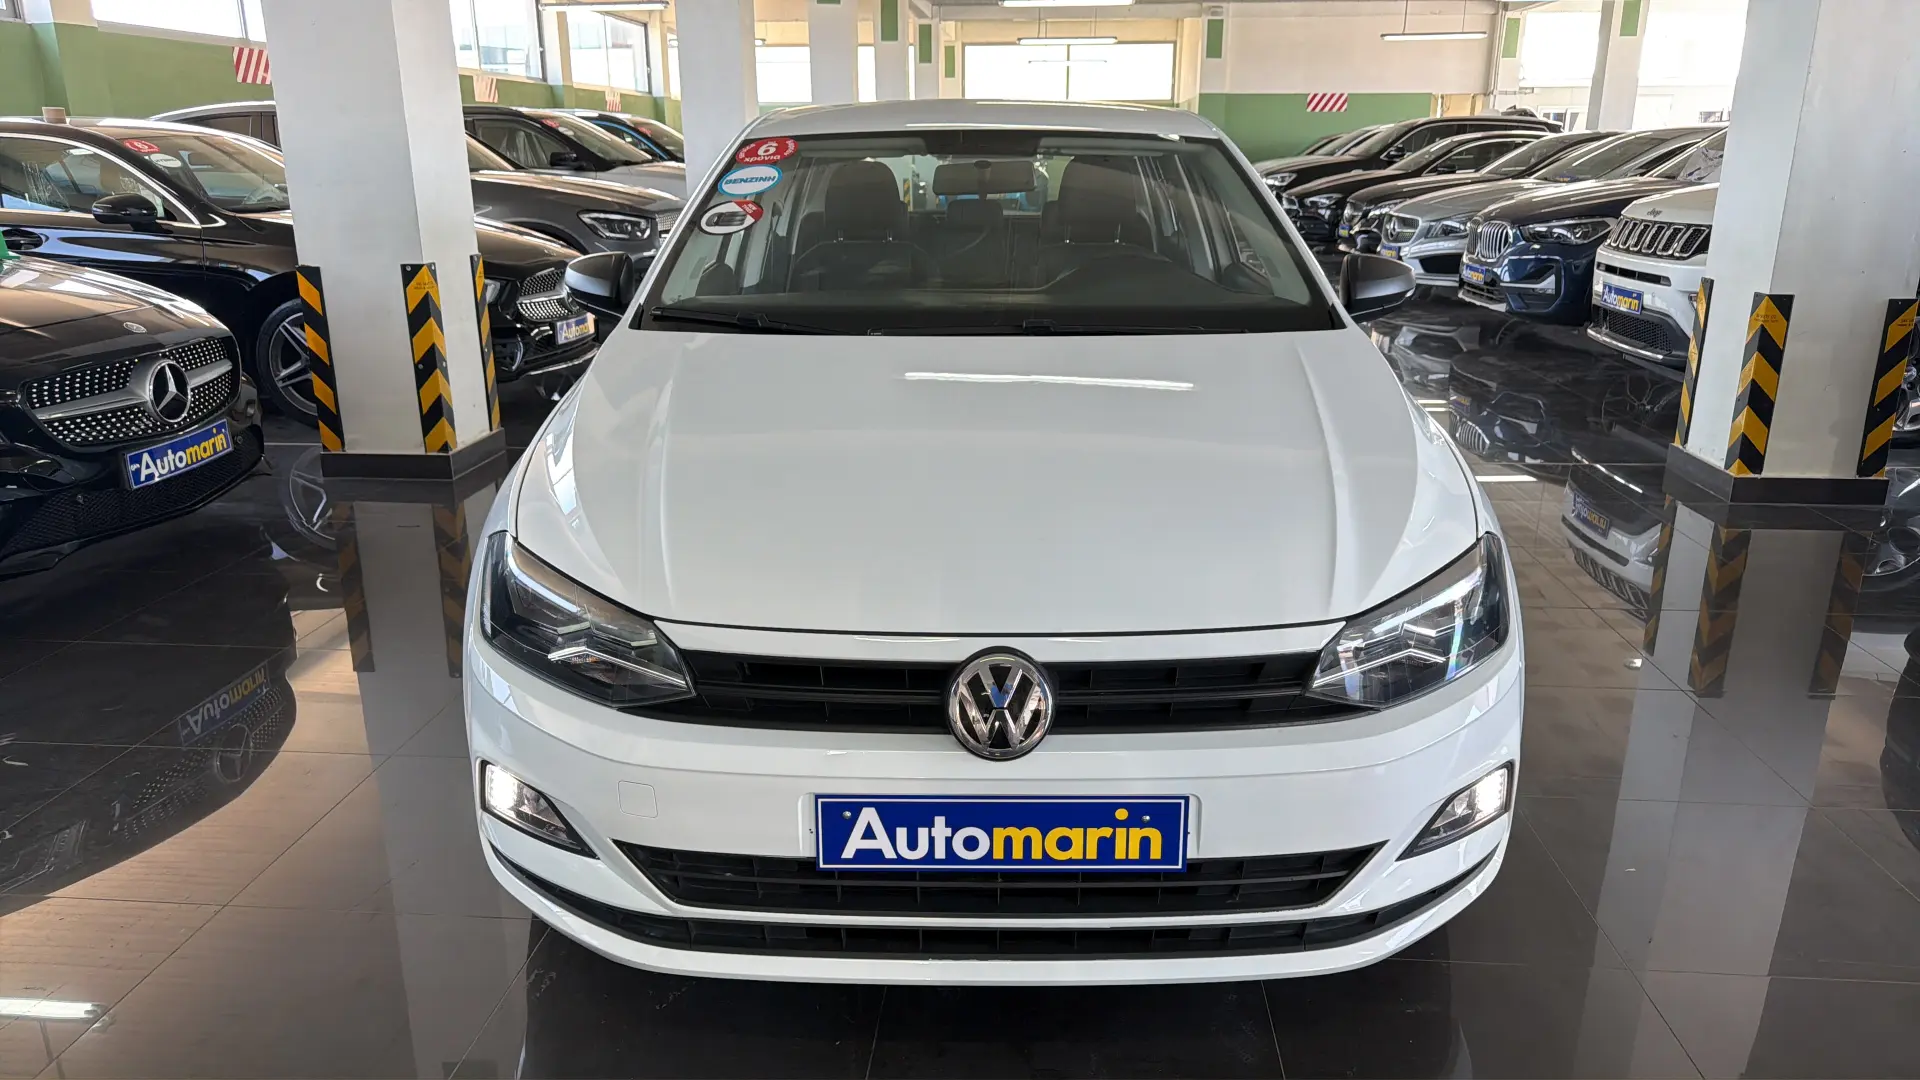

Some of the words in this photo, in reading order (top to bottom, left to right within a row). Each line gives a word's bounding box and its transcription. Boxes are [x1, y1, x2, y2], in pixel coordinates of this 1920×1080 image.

[744, 154, 781, 163] χρόνια
[757, 143, 778, 156] 6
[1602, 285, 1639, 311] Automarin
[140, 427, 228, 482] Automarin
[841, 806, 1163, 862] Automarin
